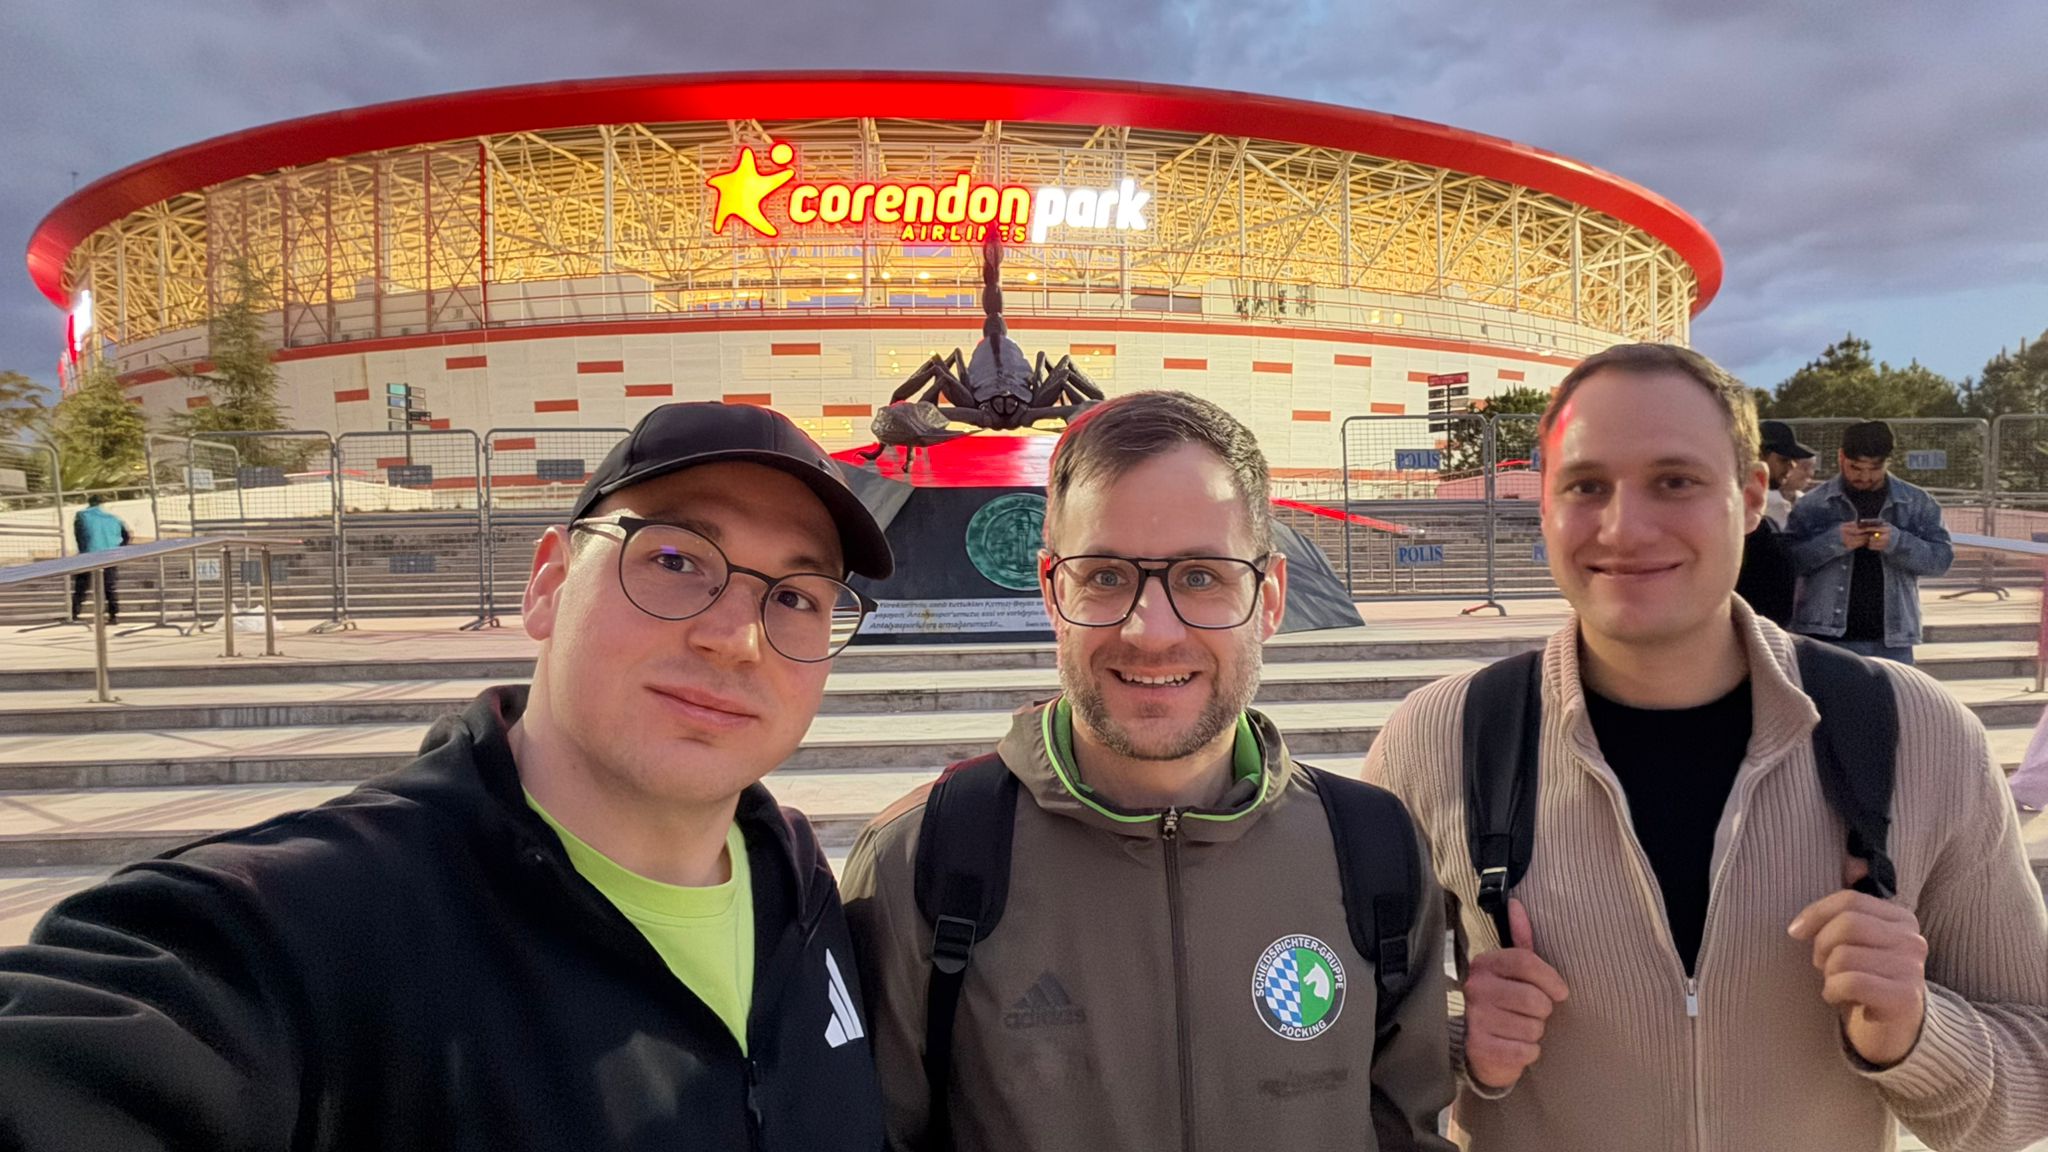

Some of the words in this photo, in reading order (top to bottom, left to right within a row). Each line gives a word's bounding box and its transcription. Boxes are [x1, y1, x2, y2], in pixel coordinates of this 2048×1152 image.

[788, 173, 1030, 224] corendon
[1031, 176, 1152, 243] park
[1255, 937, 1344, 997] SCHIEDSRICHTER-GRUPPE
[1279, 1019, 1327, 1038] POCKING
